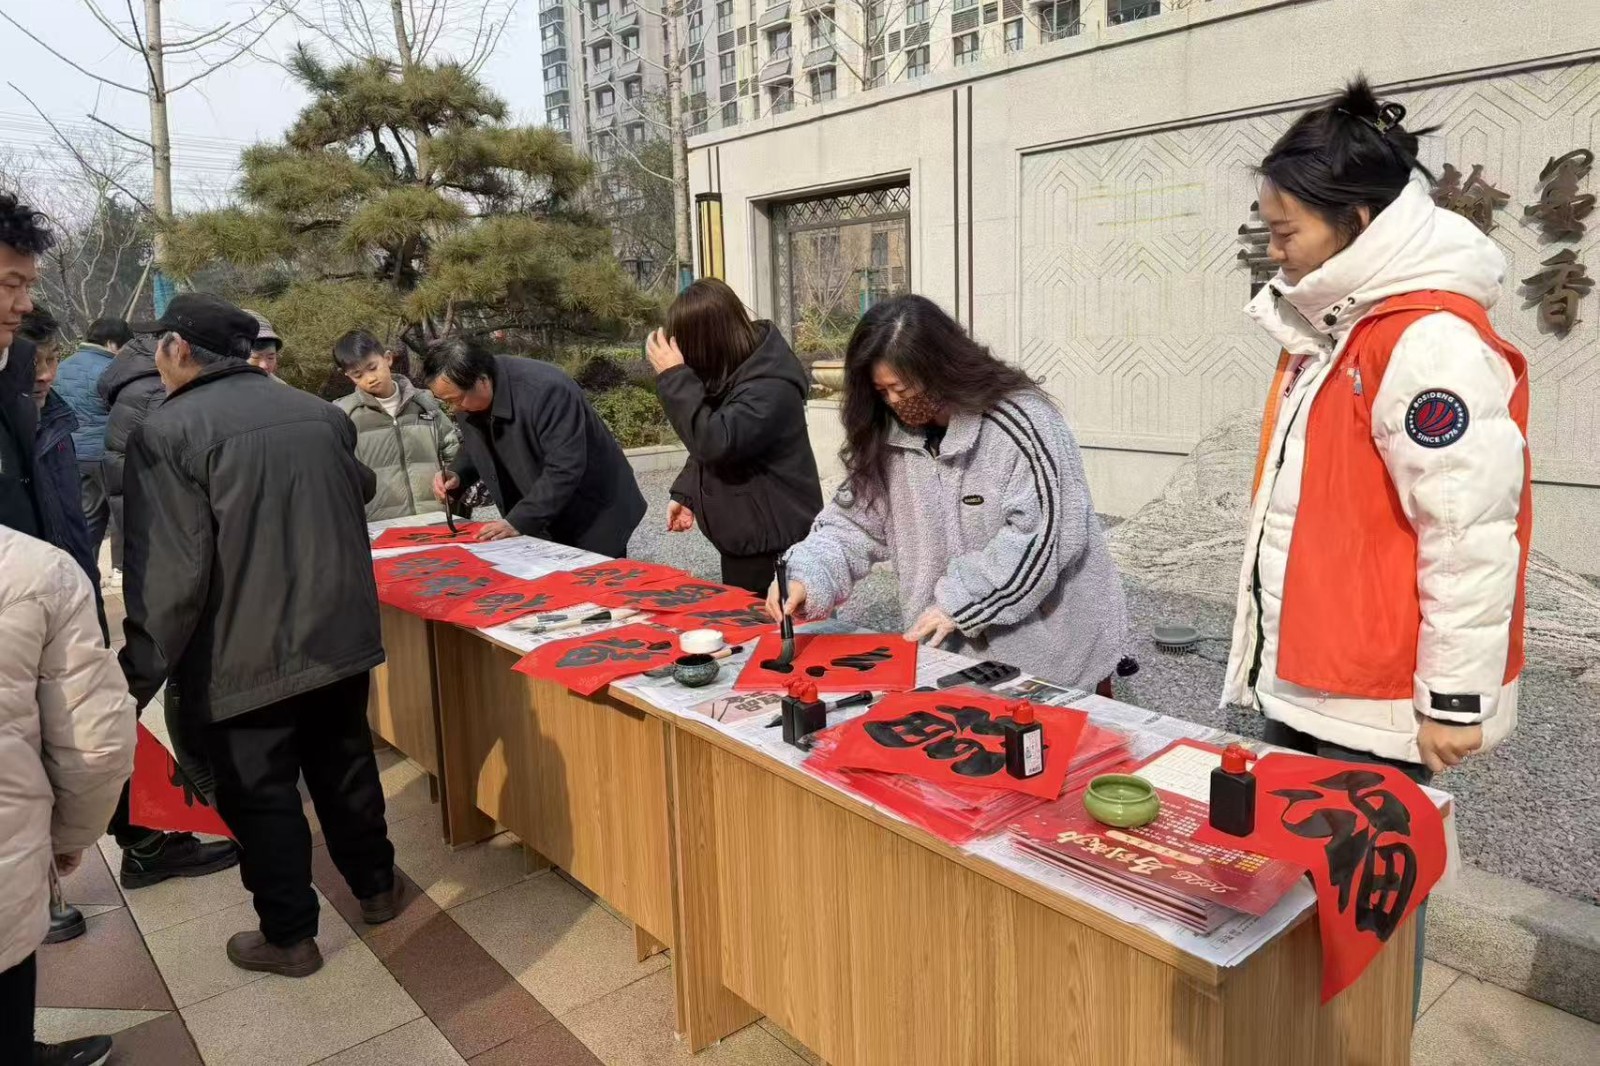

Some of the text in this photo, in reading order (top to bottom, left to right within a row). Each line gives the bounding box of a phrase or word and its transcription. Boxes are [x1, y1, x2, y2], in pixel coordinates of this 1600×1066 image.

[1413, 392, 1455, 408] BOSIDENG
[1416, 432, 1440, 443] SINCE
[1056, 829, 1176, 876] 马到成功
[1268, 769, 1417, 943] 福
[1170, 869, 1238, 894] 2026
